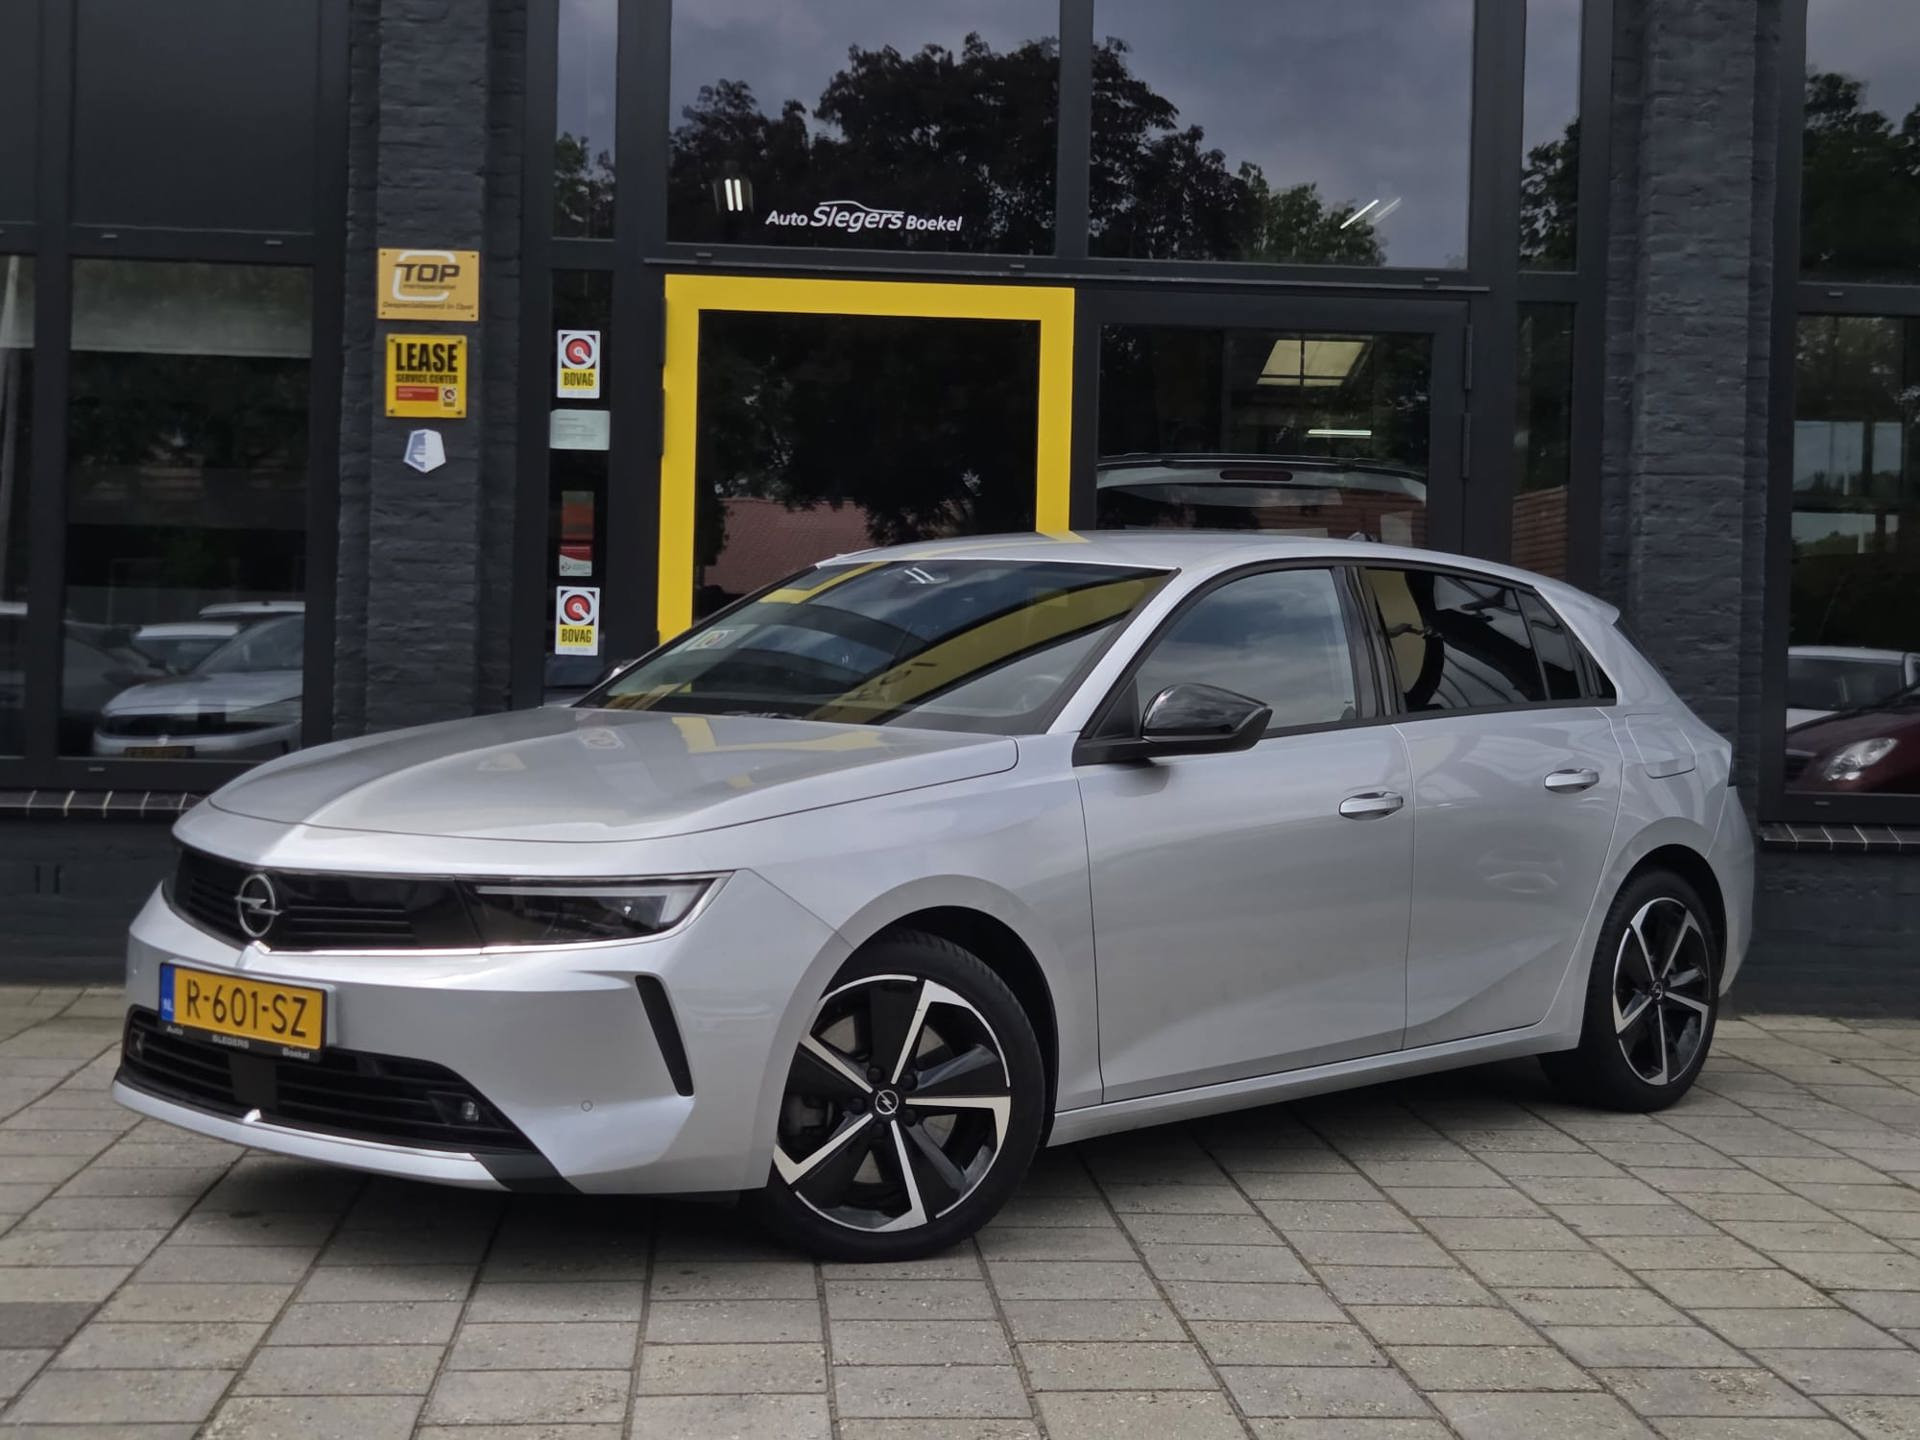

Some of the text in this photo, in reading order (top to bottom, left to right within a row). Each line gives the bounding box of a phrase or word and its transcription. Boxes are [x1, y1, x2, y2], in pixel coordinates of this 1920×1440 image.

[765, 205, 963, 233] Auto Slegers Boekel
[392, 264, 460, 283] TOP
[396, 343, 458, 373] LEASE
[396, 374, 428, 384] SERVICE
[563, 372, 595, 387] BOVAG
[561, 628, 592, 643] BOVAG
[186, 979, 308, 1039] R-601-SZ
